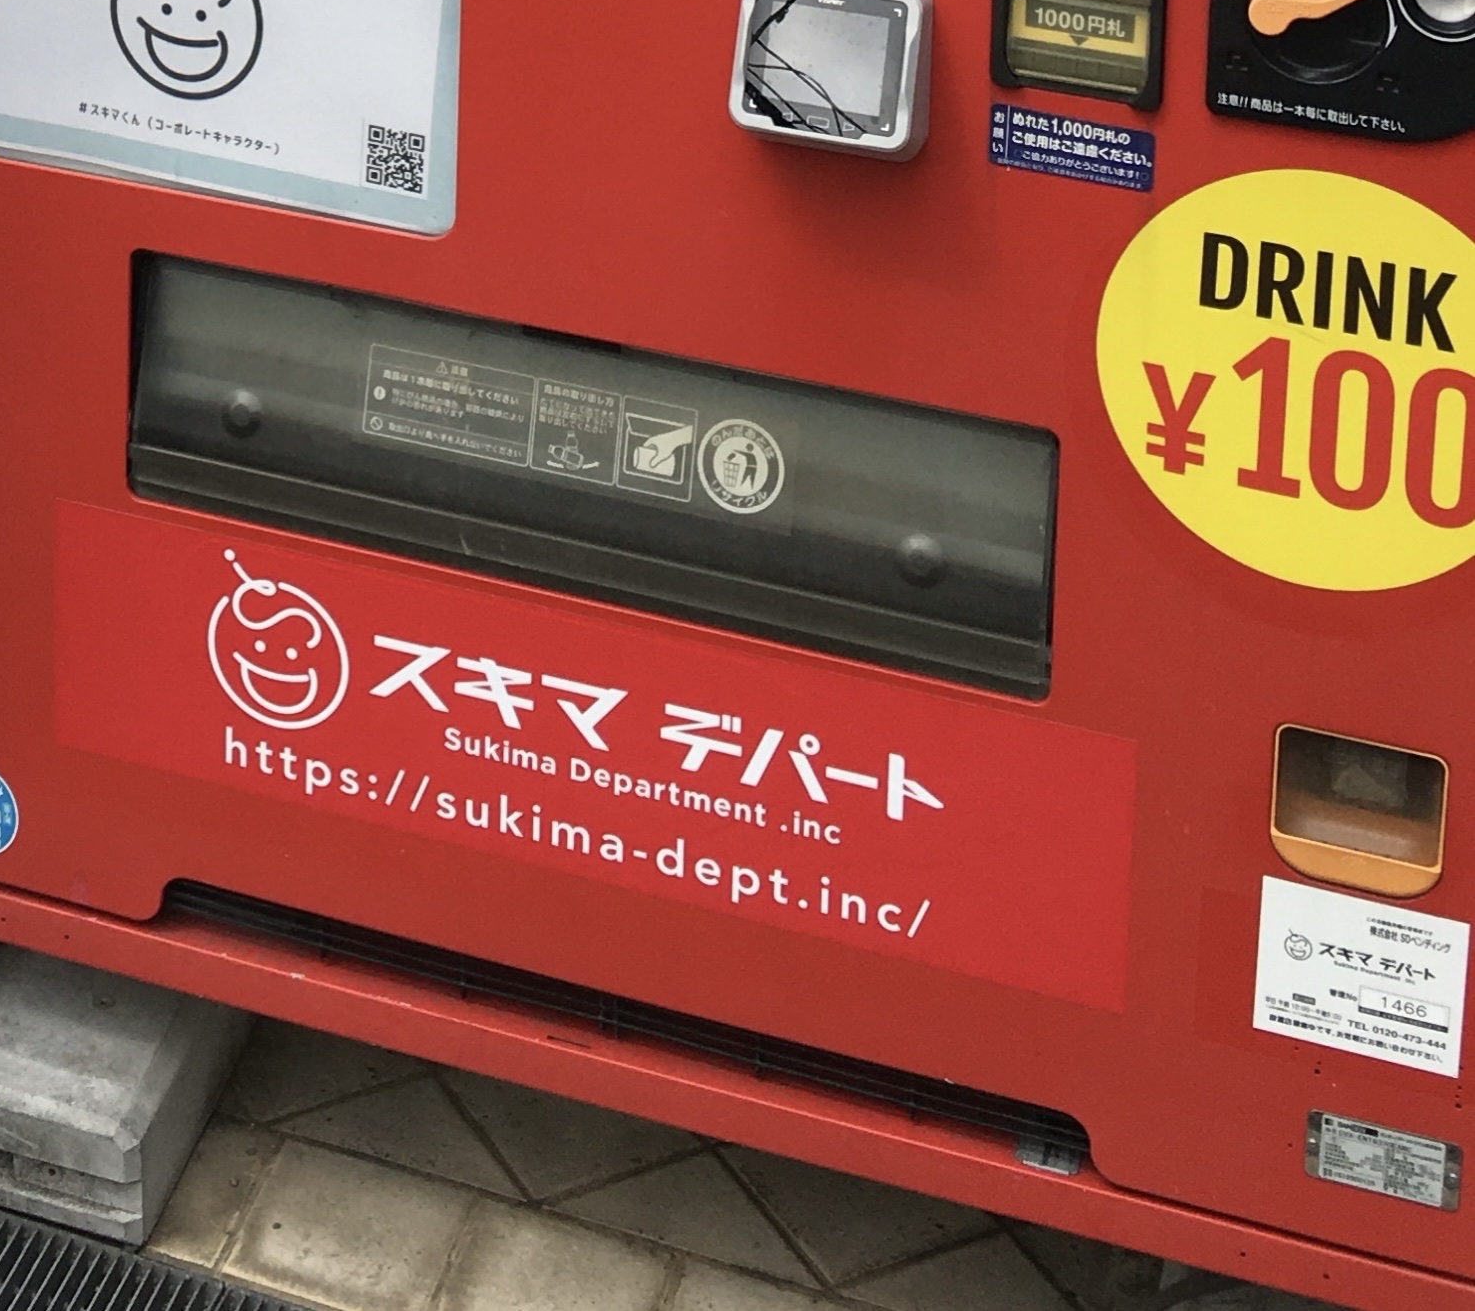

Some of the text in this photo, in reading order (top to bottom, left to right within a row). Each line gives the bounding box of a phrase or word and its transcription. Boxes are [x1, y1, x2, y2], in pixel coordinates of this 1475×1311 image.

[1033, 6, 1126, 38] 1000円札
[992, 111, 1006, 153] お願い
[1012, 112, 1132, 146] ぬれた1,000円札の
[1011, 130, 1153, 168] ご使用はご遠慮ください。
[1199, 231, 1458, 354] DRINK
[1142, 336, 1475, 529] ¥100
[711, 479, 768, 508] リサイクル
[369, 633, 945, 822] スキマ デパート
[443, 725, 842, 846] Sukima Department .inc
[224, 727, 931, 939] https://sukima-dept.inc/
[1369, 925, 1399, 941] 株式会社
[1318, 941, 1437, 981] スキマ デパート
[1380, 996, 1428, 1019] 1466
[1346, 1018, 1447, 1051] TEL 0120-473-444
